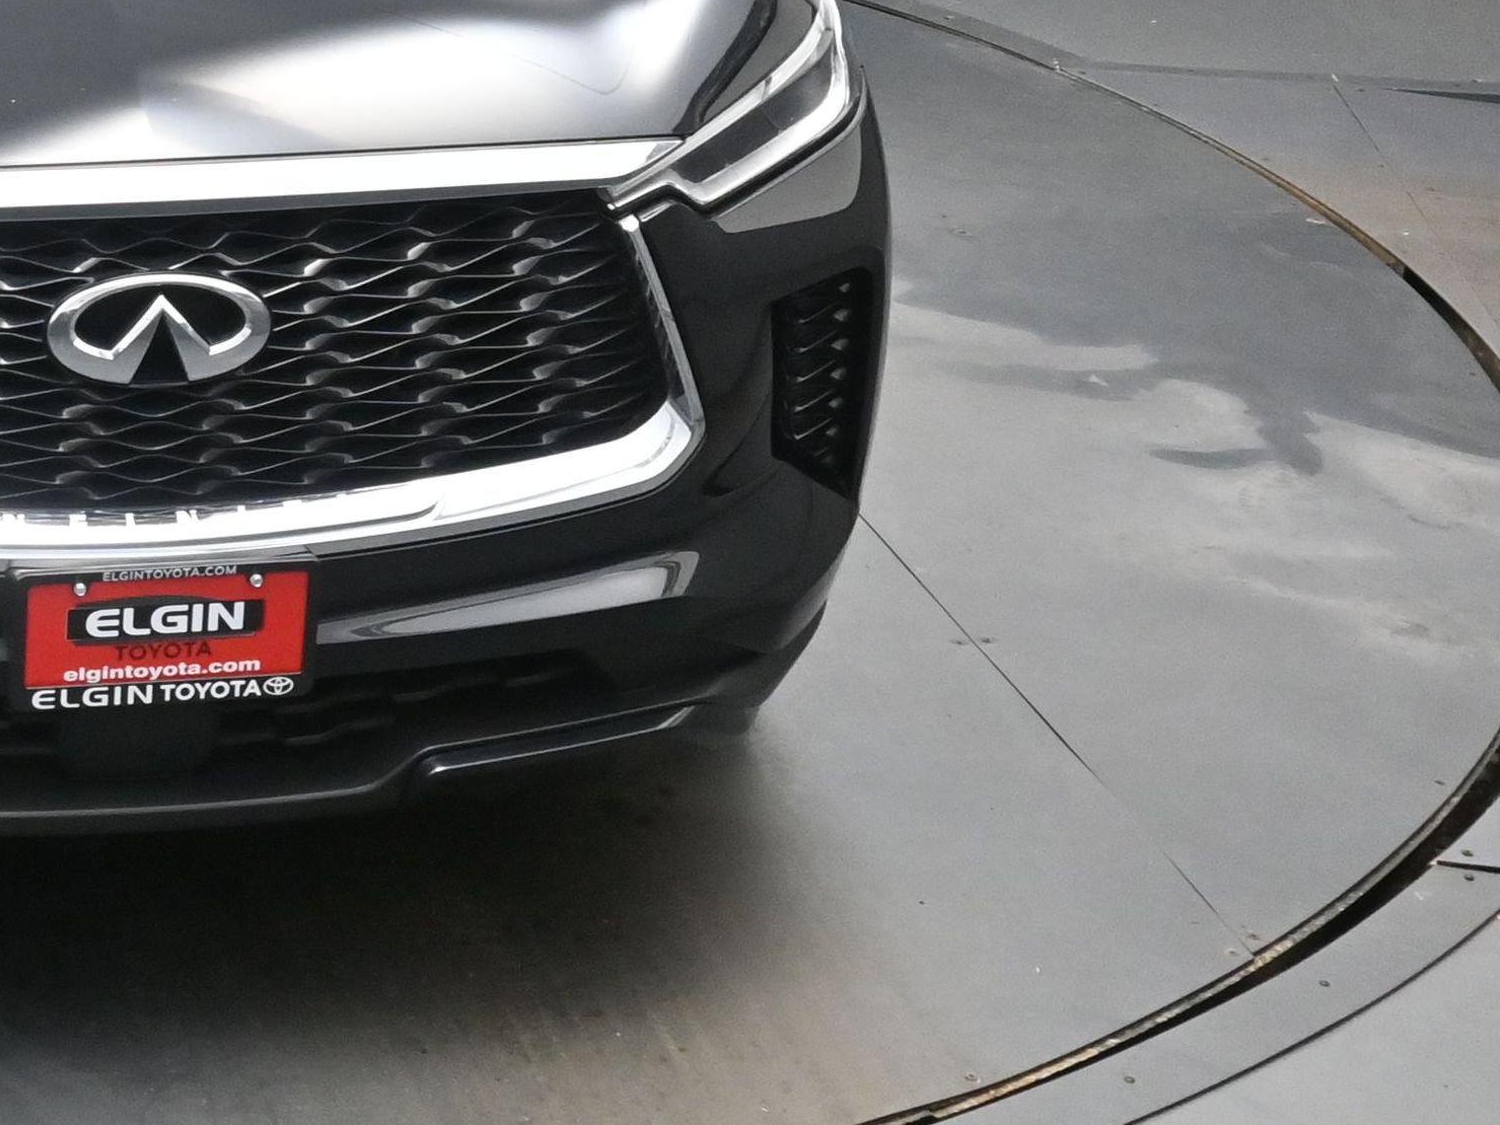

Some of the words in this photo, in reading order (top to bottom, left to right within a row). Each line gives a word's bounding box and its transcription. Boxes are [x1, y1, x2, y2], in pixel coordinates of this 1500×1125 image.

[102, 565, 237, 582] ELGINTOYOTA.COM
[85, 601, 245, 638] ELGIN
[115, 641, 212, 662] TOYOTA
[63, 659, 261, 683] elgintoyota.com
[31, 684, 154, 710] ELGIN
[160, 679, 262, 702] TOYOTA
